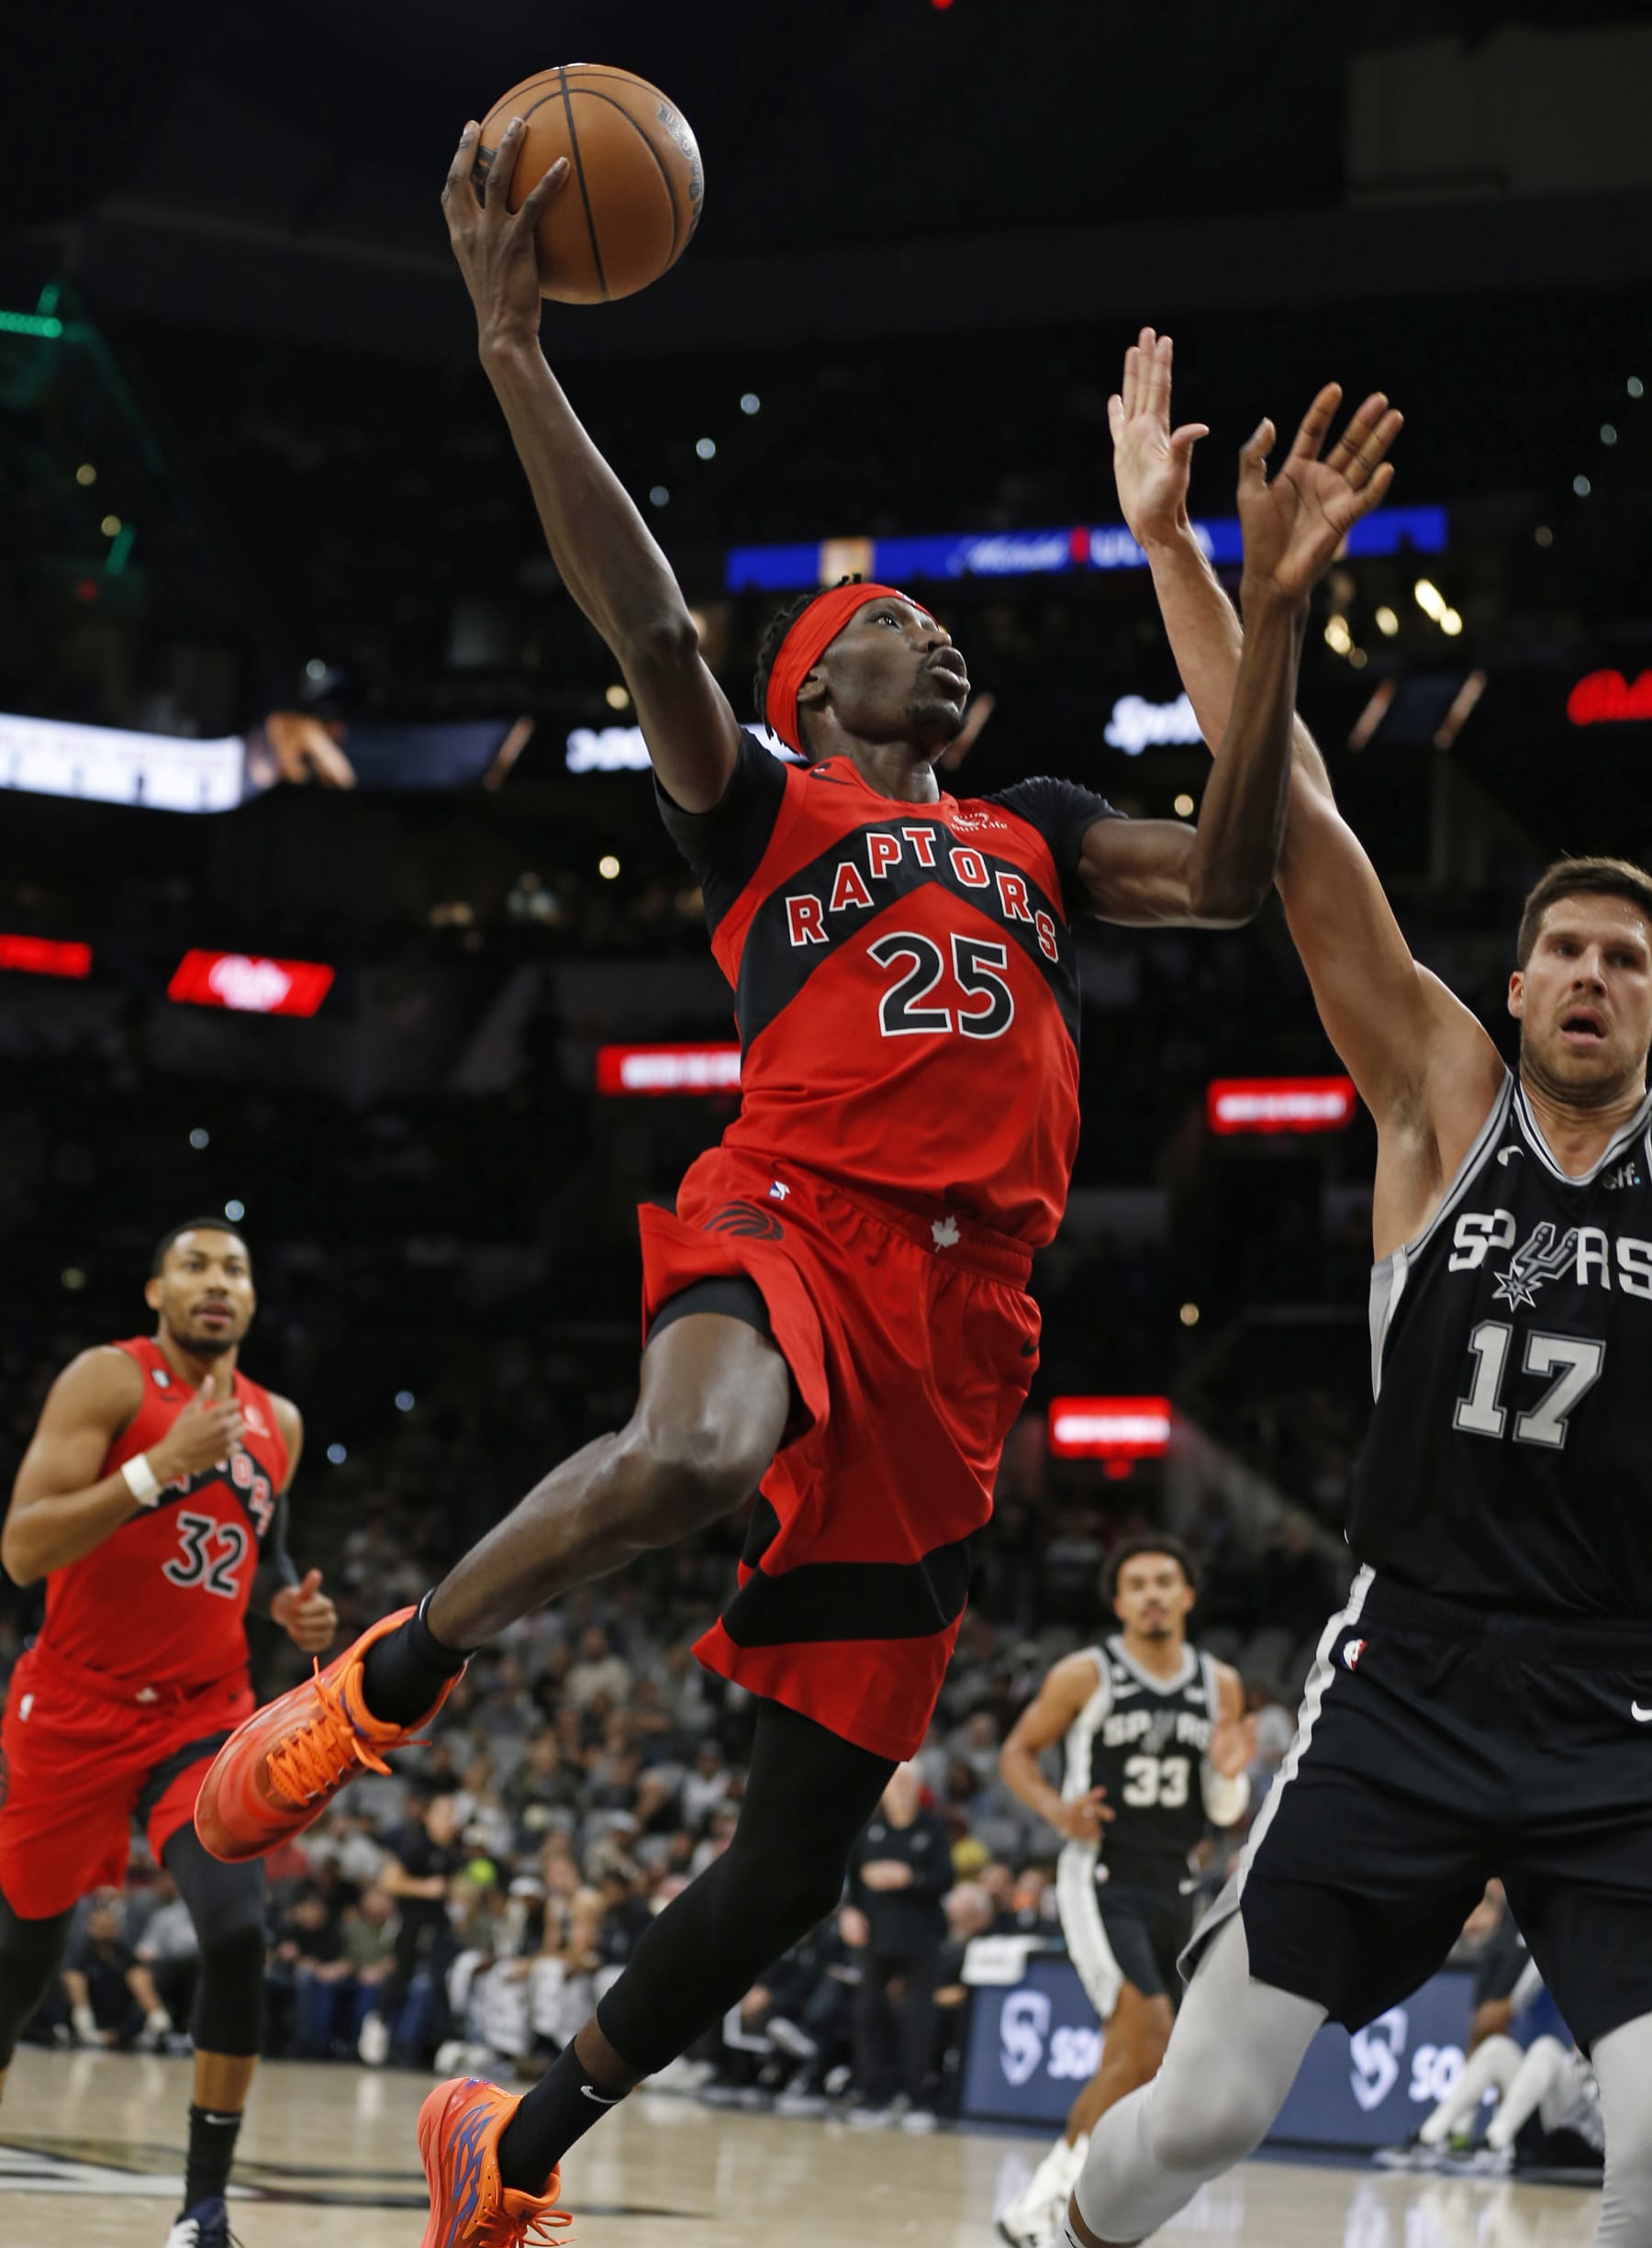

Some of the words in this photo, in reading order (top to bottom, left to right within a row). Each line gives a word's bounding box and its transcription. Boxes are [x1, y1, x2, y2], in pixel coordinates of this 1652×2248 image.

[785, 827, 1058, 964] RAPTORS
[865, 931, 1015, 1040] 25
[1452, 1319, 1607, 1450] 17
[162, 1510, 249, 1600] 32
[1122, 1754, 1191, 1808] 33
